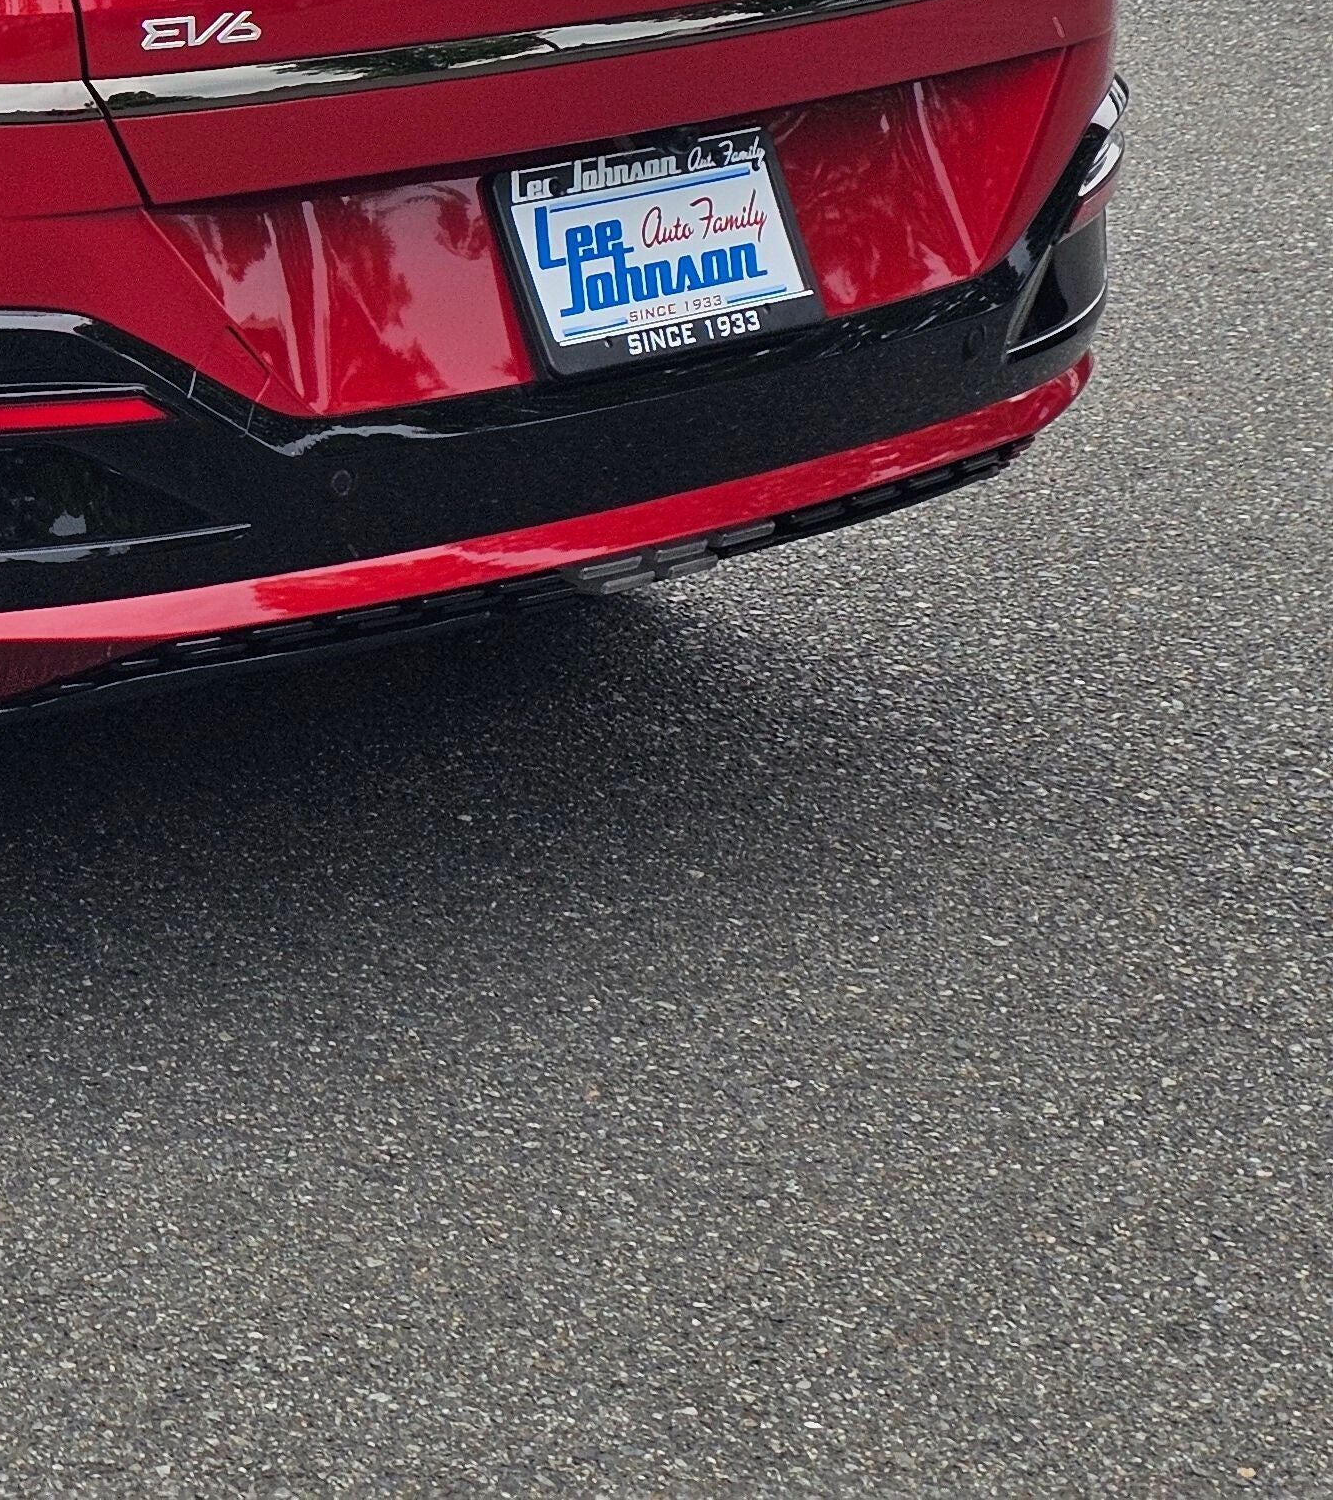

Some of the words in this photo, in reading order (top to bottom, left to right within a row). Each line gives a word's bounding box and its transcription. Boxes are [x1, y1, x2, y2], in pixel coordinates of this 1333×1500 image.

[141, 10, 262, 50] EV6
[566, 156, 682, 193] Johnson
[534, 206, 634, 270] Lee
[641, 205, 694, 248] Auto
[689, 188, 768, 243] Family
[560, 241, 768, 317] Johnson
[629, 304, 676, 323] SINCE
[685, 295, 722, 312] 1933
[627, 323, 697, 355] SINCE
[704, 310, 761, 339] 1933
